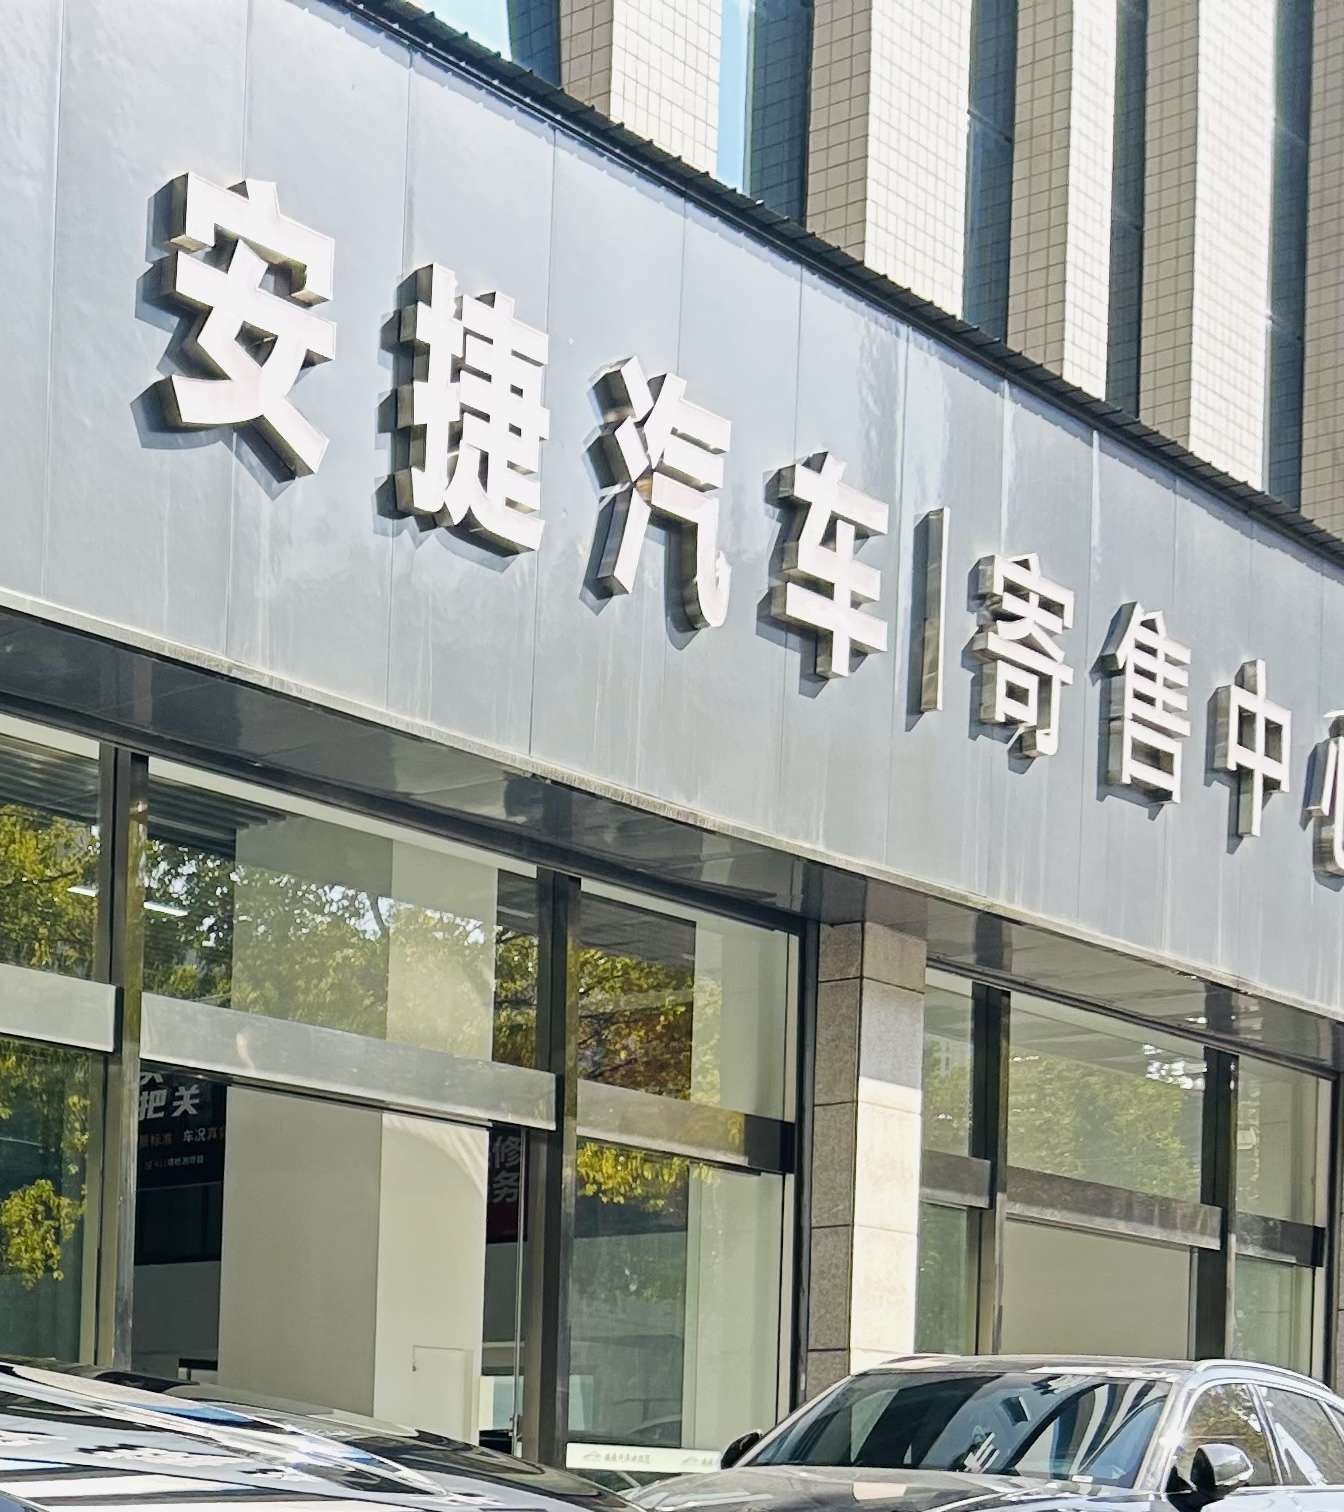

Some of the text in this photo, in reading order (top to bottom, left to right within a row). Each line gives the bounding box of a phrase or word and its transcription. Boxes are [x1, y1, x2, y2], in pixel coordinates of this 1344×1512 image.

[139, 1084, 200, 1121] 把关
[489, 1135, 521, 1168] 修
[489, 1170, 520, 1203] 务
